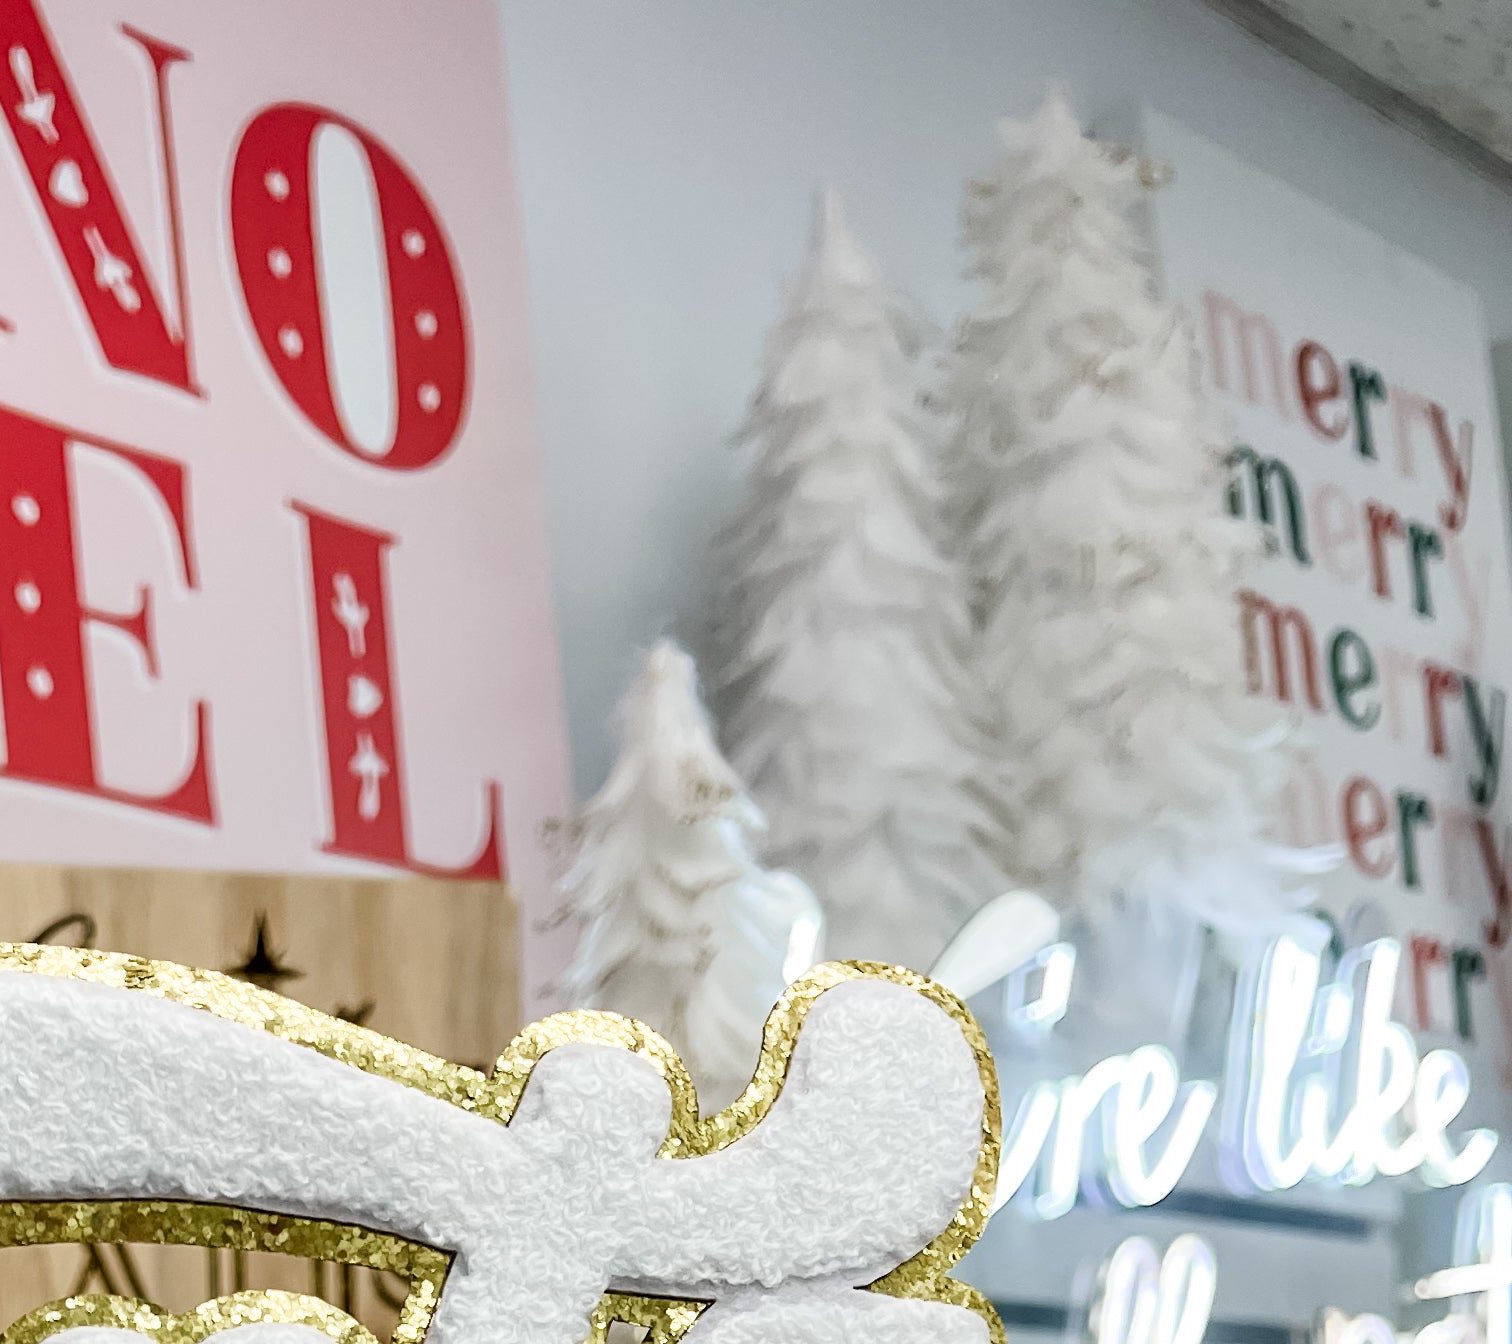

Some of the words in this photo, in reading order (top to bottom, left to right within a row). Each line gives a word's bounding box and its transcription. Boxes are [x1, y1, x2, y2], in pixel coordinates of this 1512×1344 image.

[1200, 288, 1476, 532] merry
[1234, 586, 1508, 808] merry
[1240, 932, 1498, 1192] like
